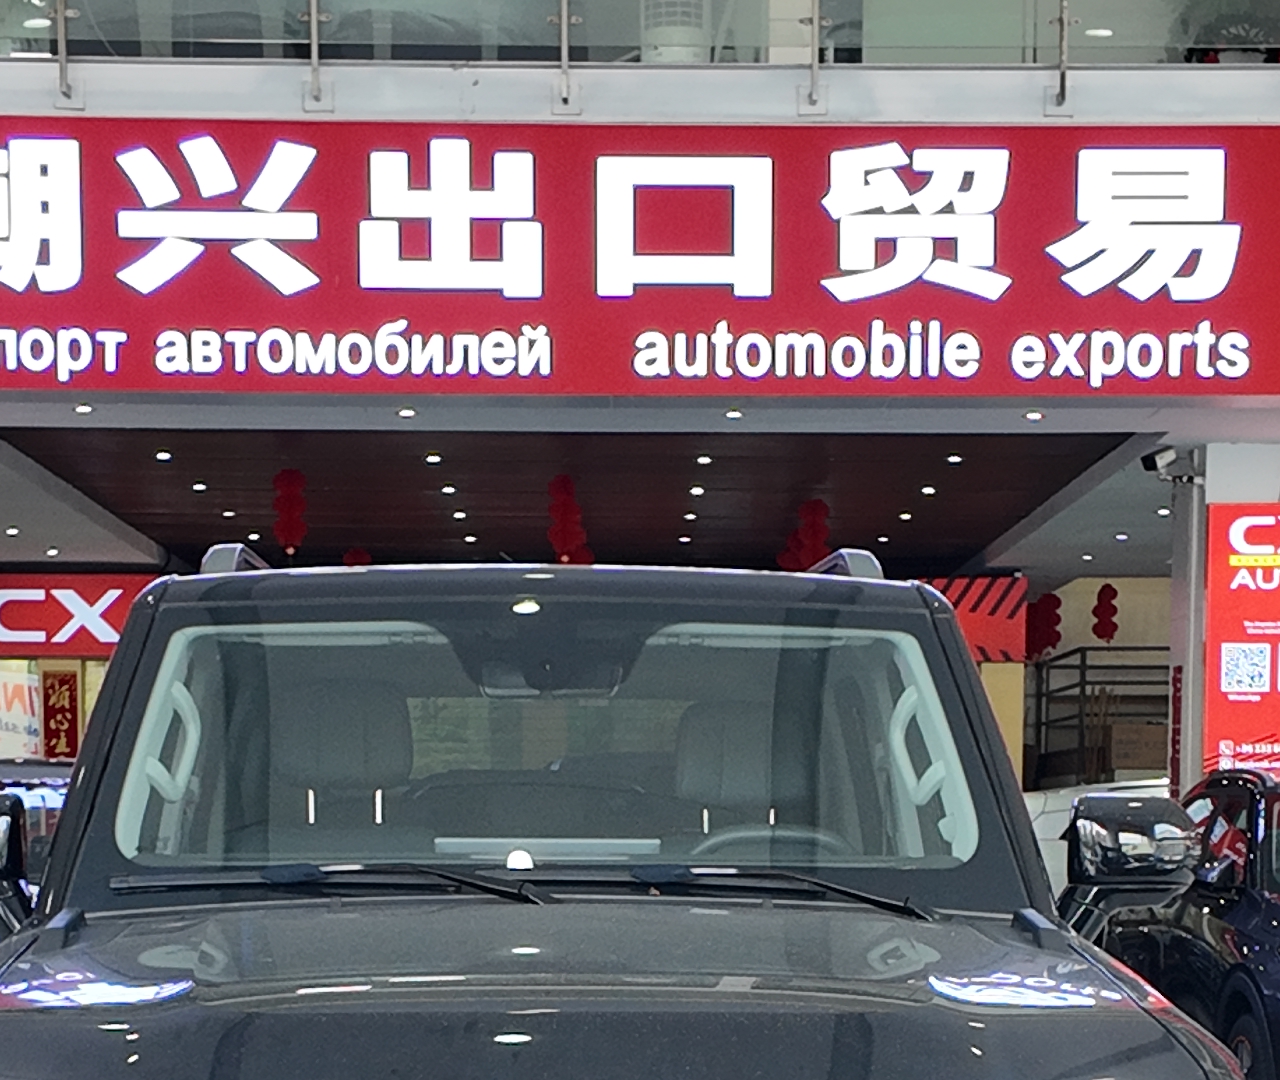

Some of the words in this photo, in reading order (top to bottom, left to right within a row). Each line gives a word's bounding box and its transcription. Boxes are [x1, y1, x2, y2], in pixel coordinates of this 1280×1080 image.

[154, 319, 552, 378] автомобилей
[632, 319, 982, 379] automobile
[1010, 319, 1251, 388] exports
